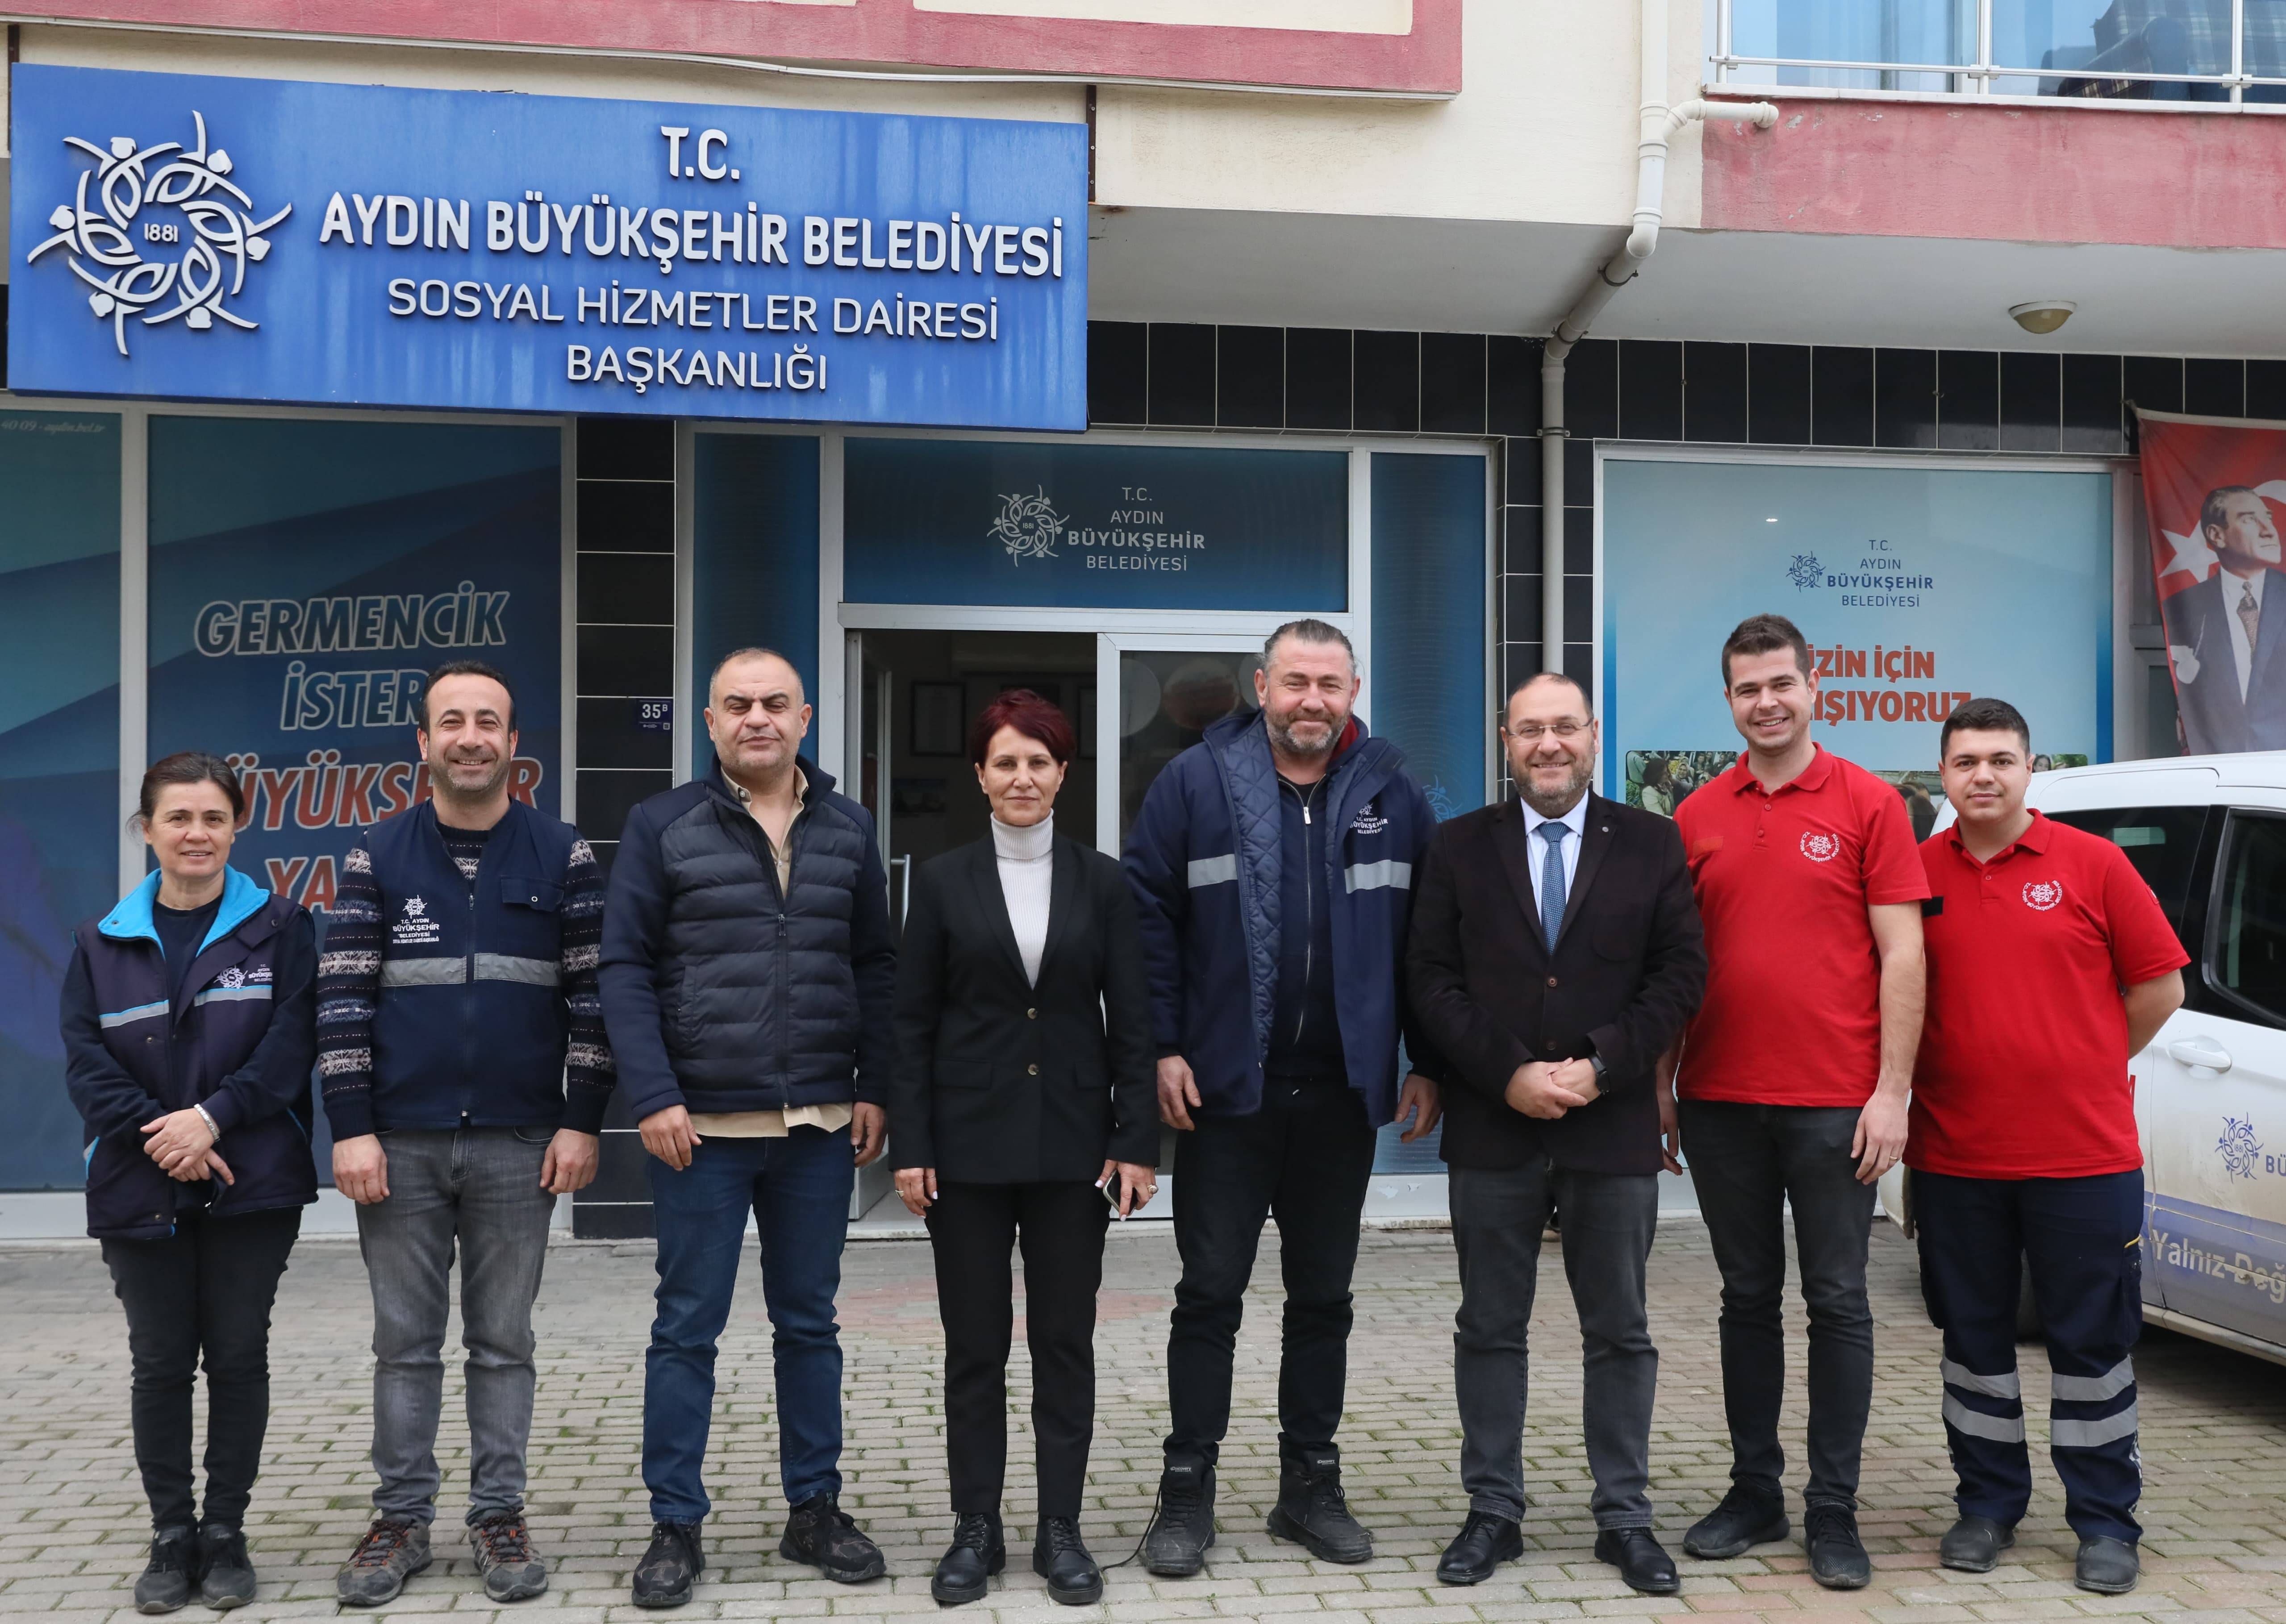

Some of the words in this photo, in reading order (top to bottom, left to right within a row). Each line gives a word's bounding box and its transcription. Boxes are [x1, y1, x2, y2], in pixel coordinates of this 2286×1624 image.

[660, 125, 740, 180] T.C.
[144, 223, 178, 242] 1881
[319, 191, 470, 250] AYDIN
[487, 190, 788, 274] BÜYÜKŞEHİR
[803, 212, 1062, 278] BELEDİYESİ
[388, 278, 564, 321] SOSYAL
[577, 280, 818, 333] HİZMETLER
[833, 292, 997, 340] DAİRESİ
[567, 343, 826, 393] BAŞKANLIĞI
[1122, 487, 1153, 501] T.C.
[1110, 510, 1163, 525] AYDIN
[1068, 528, 1205, 551] BÜYÜKŞEHİR
[1869, 540, 1892, 551] T.C.
[1086, 554, 1187, 571] BELEDİYESİ
[1860, 558, 1901, 570] AYDIN
[1827, 573, 1933, 591] BÜYÜKŞEHİR
[1842, 594, 1919, 607] BELEDİYESİ
[195, 580, 510, 657] GERMENCİK
[1807, 644, 1866, 678] İZİN
[1874, 645, 1934, 683] İÇİN
[280, 661, 430, 731] İSTER
[393, 922, 439, 932] BÜYÜKŞEHİR
